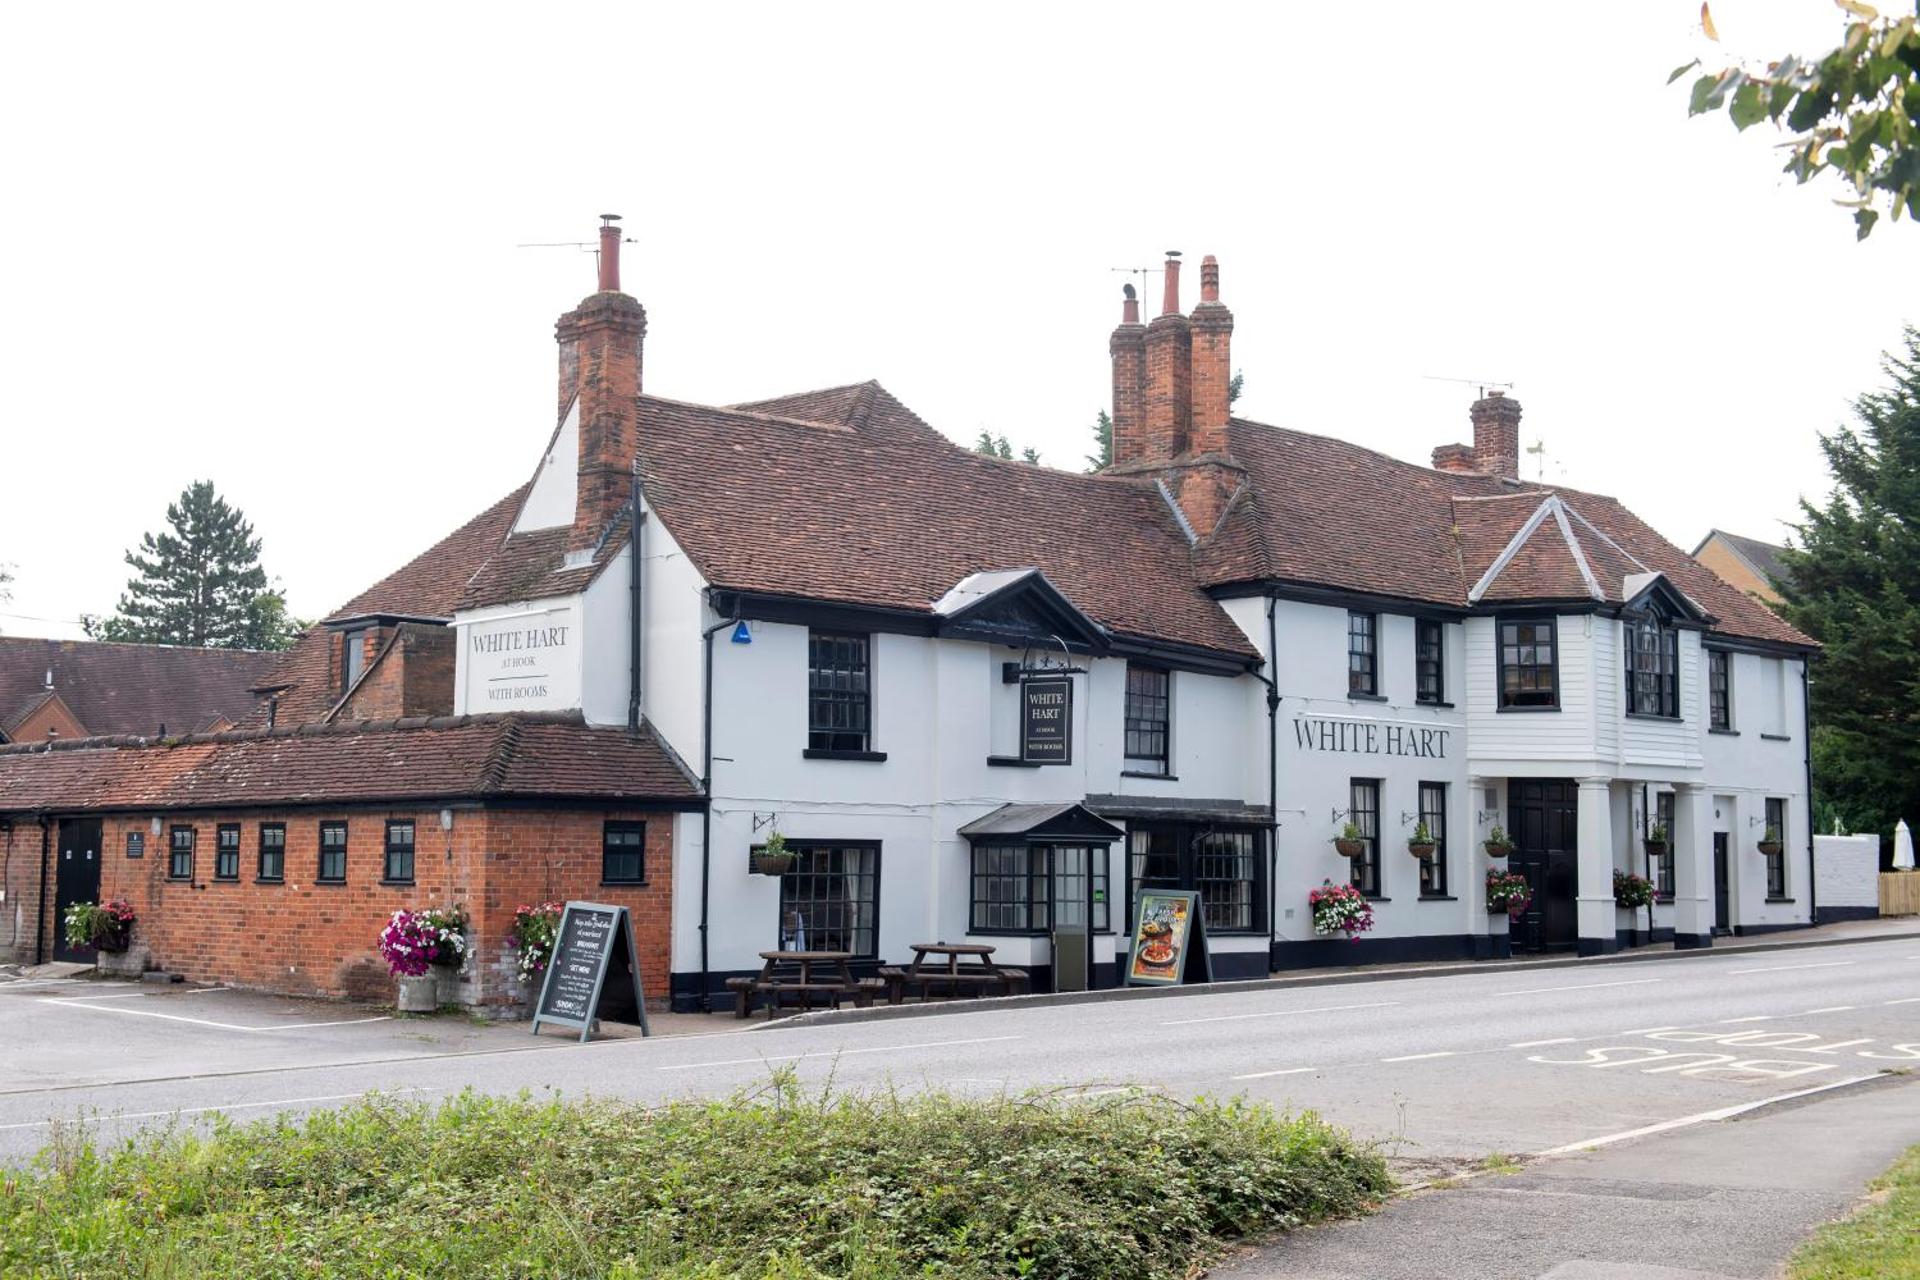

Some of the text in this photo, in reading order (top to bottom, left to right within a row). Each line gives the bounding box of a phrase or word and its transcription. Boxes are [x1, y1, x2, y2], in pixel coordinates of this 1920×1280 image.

[473, 626, 569, 654] WHITE HART
[512, 656, 536, 669] HOOK
[488, 685, 548, 700] WITH ROOMS
[1029, 693, 1064, 705] WHITE
[1032, 708, 1060, 719] HART
[1293, 718, 1450, 759] WHITE HART
[1526, 1046, 1840, 1085] BUS
